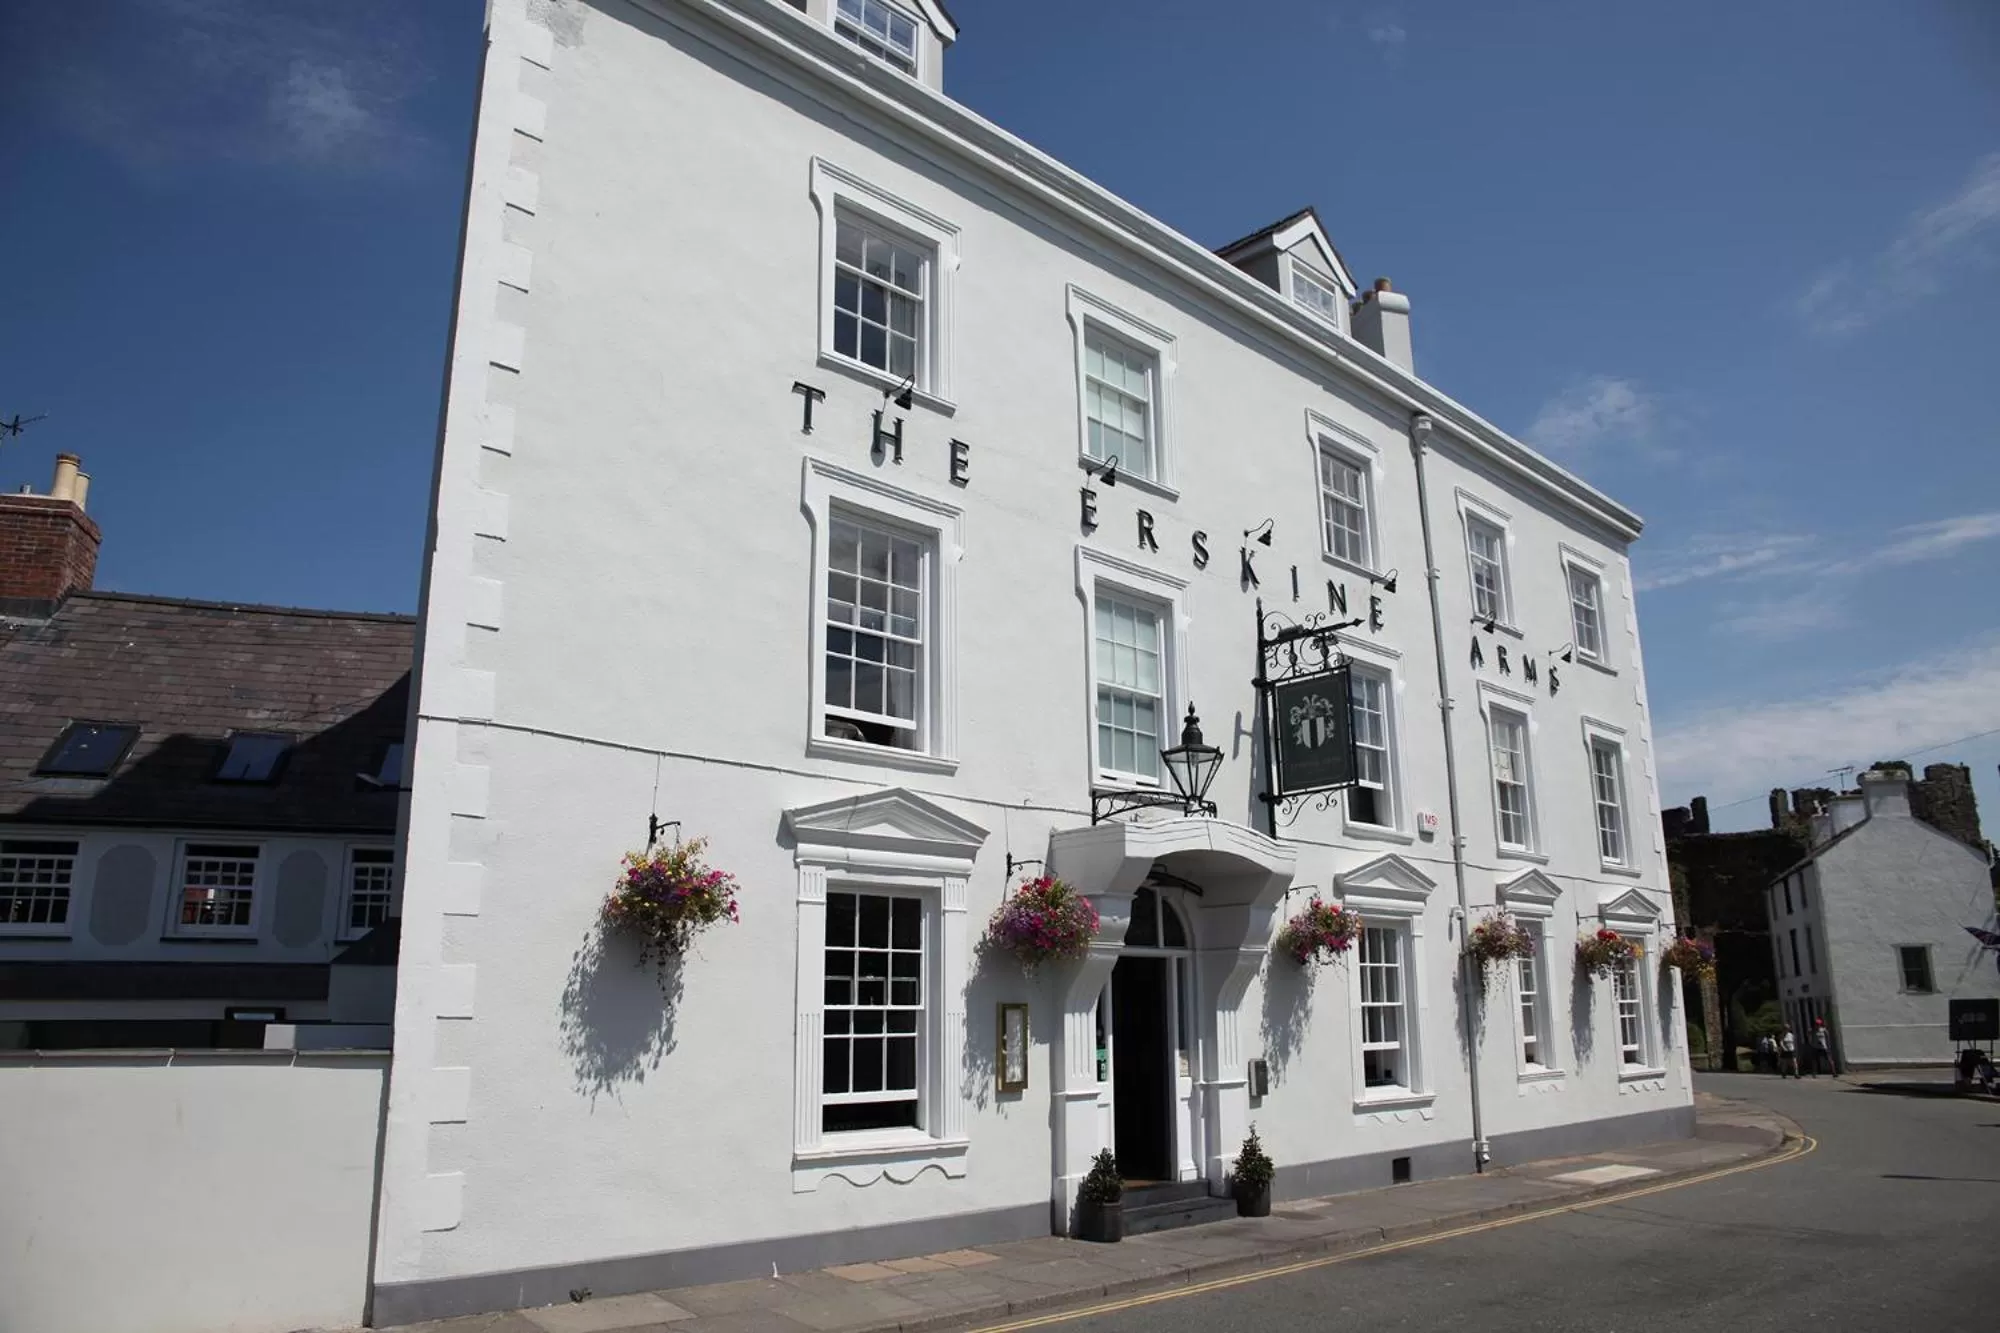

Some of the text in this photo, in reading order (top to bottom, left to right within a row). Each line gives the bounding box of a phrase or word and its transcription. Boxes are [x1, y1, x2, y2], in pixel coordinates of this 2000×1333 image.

[792, 381, 1560, 696] THE ERSKINE ARMS
